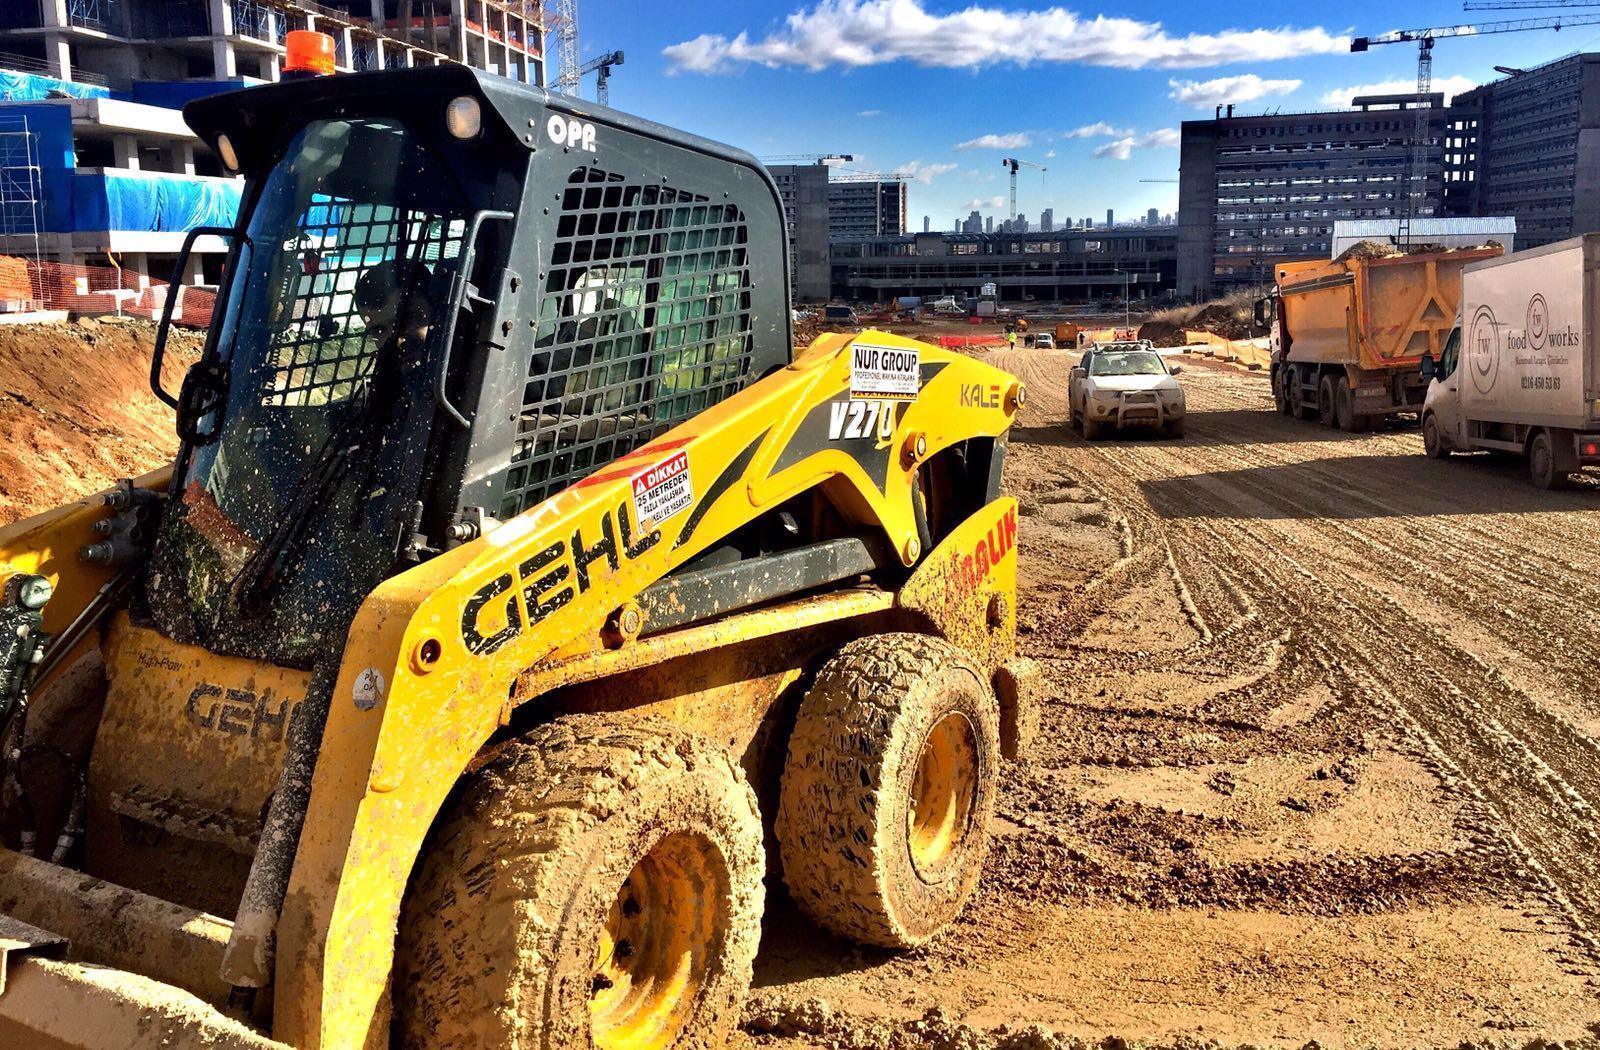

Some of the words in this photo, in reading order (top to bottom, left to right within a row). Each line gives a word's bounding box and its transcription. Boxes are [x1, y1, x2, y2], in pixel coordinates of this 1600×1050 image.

[547, 114, 597, 153] OPR
[1507, 330, 1527, 350] food
[1548, 325, 1580, 348] works
[854, 349, 879, 370] NUR
[881, 351, 917, 373] GROUP
[960, 383, 1000, 408] KALE
[1534, 376, 1545, 390] 450
[828, 401, 894, 441] V270
[637, 494, 648, 507] 25
[648, 472, 688, 500] METREDEN
[643, 501, 658, 514] FAZLA
[663, 506, 670, 516] VE
[461, 501, 662, 656] GEHL
